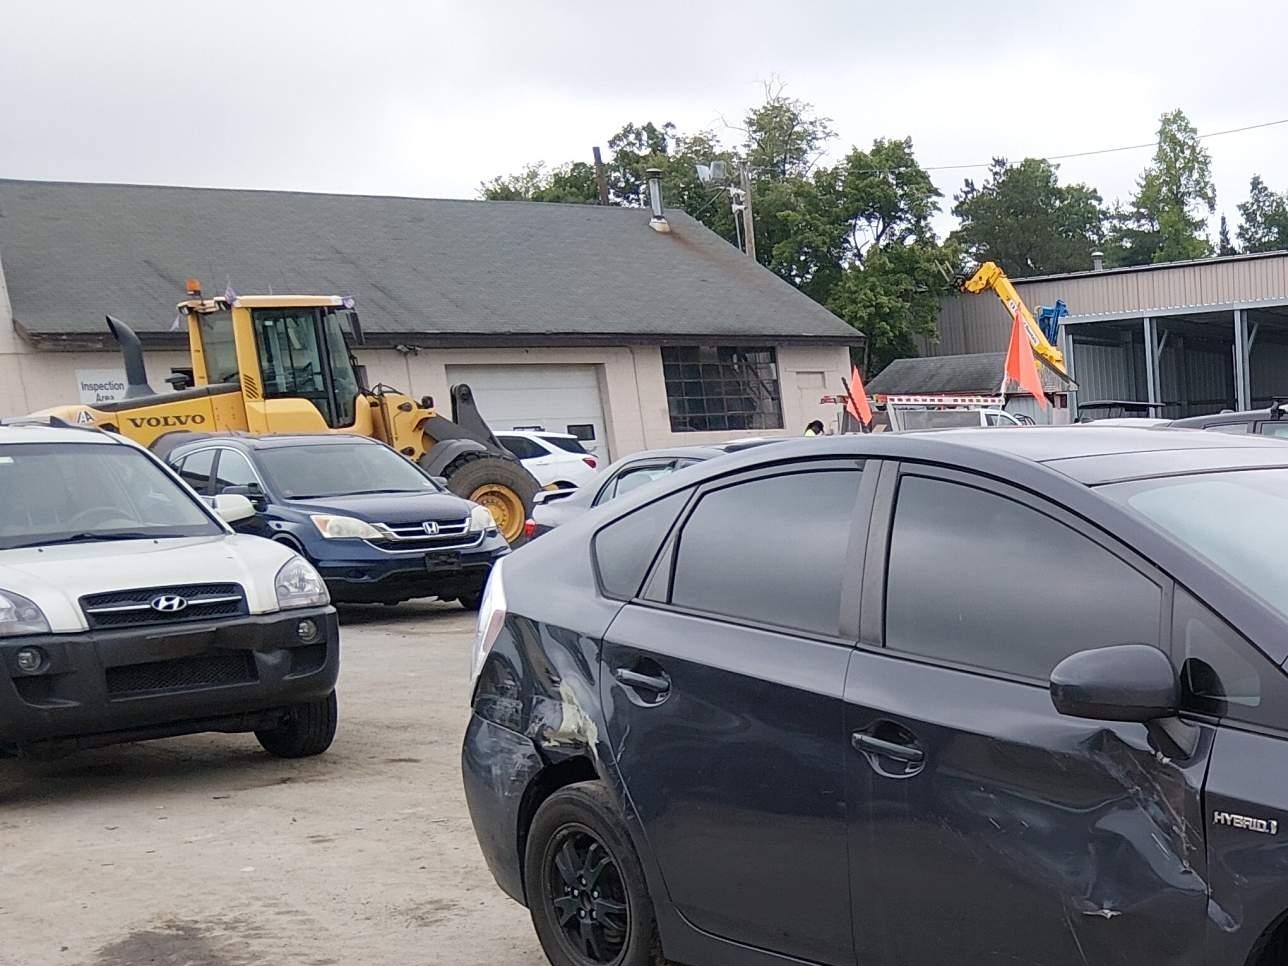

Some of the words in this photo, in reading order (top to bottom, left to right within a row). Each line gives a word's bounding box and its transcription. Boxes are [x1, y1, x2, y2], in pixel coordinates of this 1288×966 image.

[81, 382, 125, 393] Inspection
[128, 414, 205, 428] VOLVO
[1213, 811, 1268, 833] HYBRID
